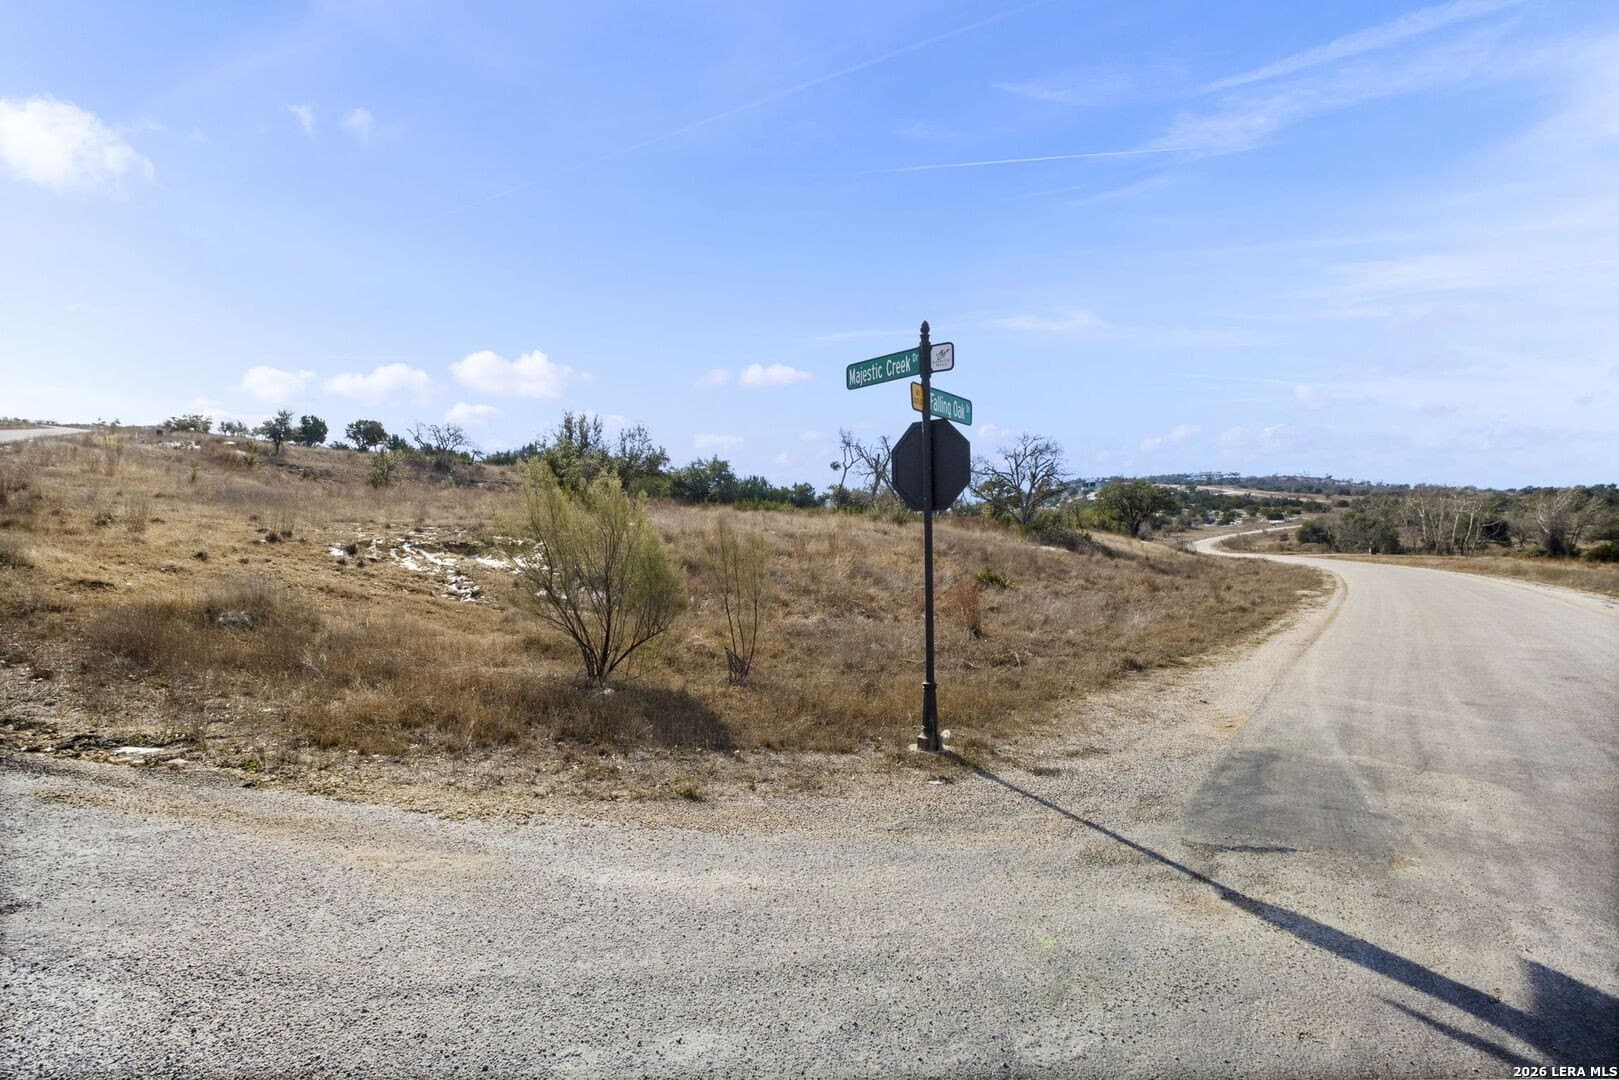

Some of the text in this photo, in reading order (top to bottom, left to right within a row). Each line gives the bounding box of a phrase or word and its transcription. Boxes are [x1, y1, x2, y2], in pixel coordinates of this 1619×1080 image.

[849, 363, 883, 386] Majestic
[886, 355, 911, 376] Creek
[930, 392, 952, 418] Falling
[953, 400, 965, 419] Oak
